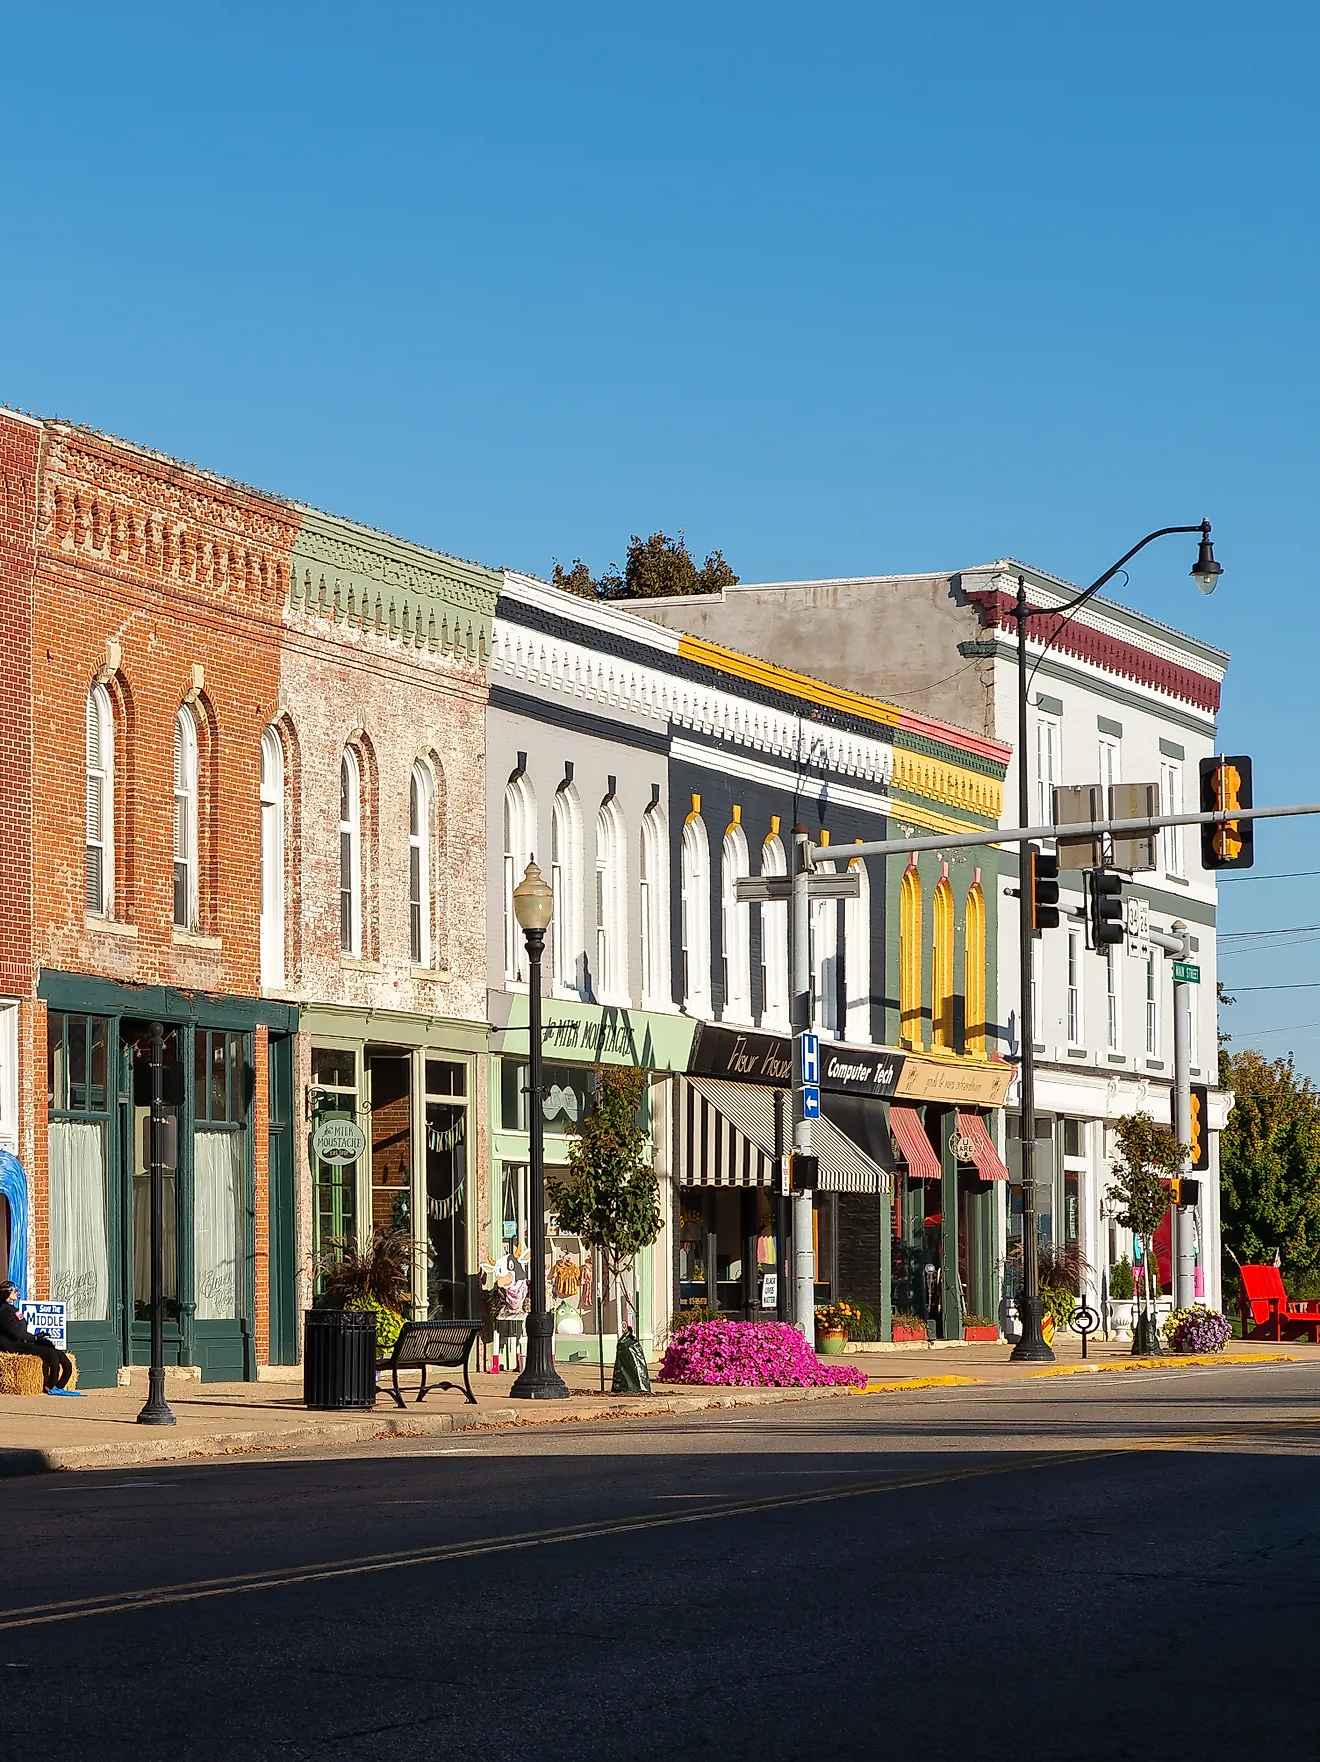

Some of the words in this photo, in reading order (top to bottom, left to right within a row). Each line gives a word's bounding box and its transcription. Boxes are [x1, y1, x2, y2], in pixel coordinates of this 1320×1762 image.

[554, 1019, 581, 1048] MILK
[580, 1021, 635, 1057] MOUSTACHE
[727, 1035, 759, 1073] Flour
[805, 1038, 818, 1080] H
[827, 1056, 872, 1084] Computer
[873, 1061, 894, 1085] Tech
[318, 1138, 361, 1148] MOUSTACHE
[335, 1127, 354, 1136] MILK
[27, 1311, 64, 1326] MIDDLE
